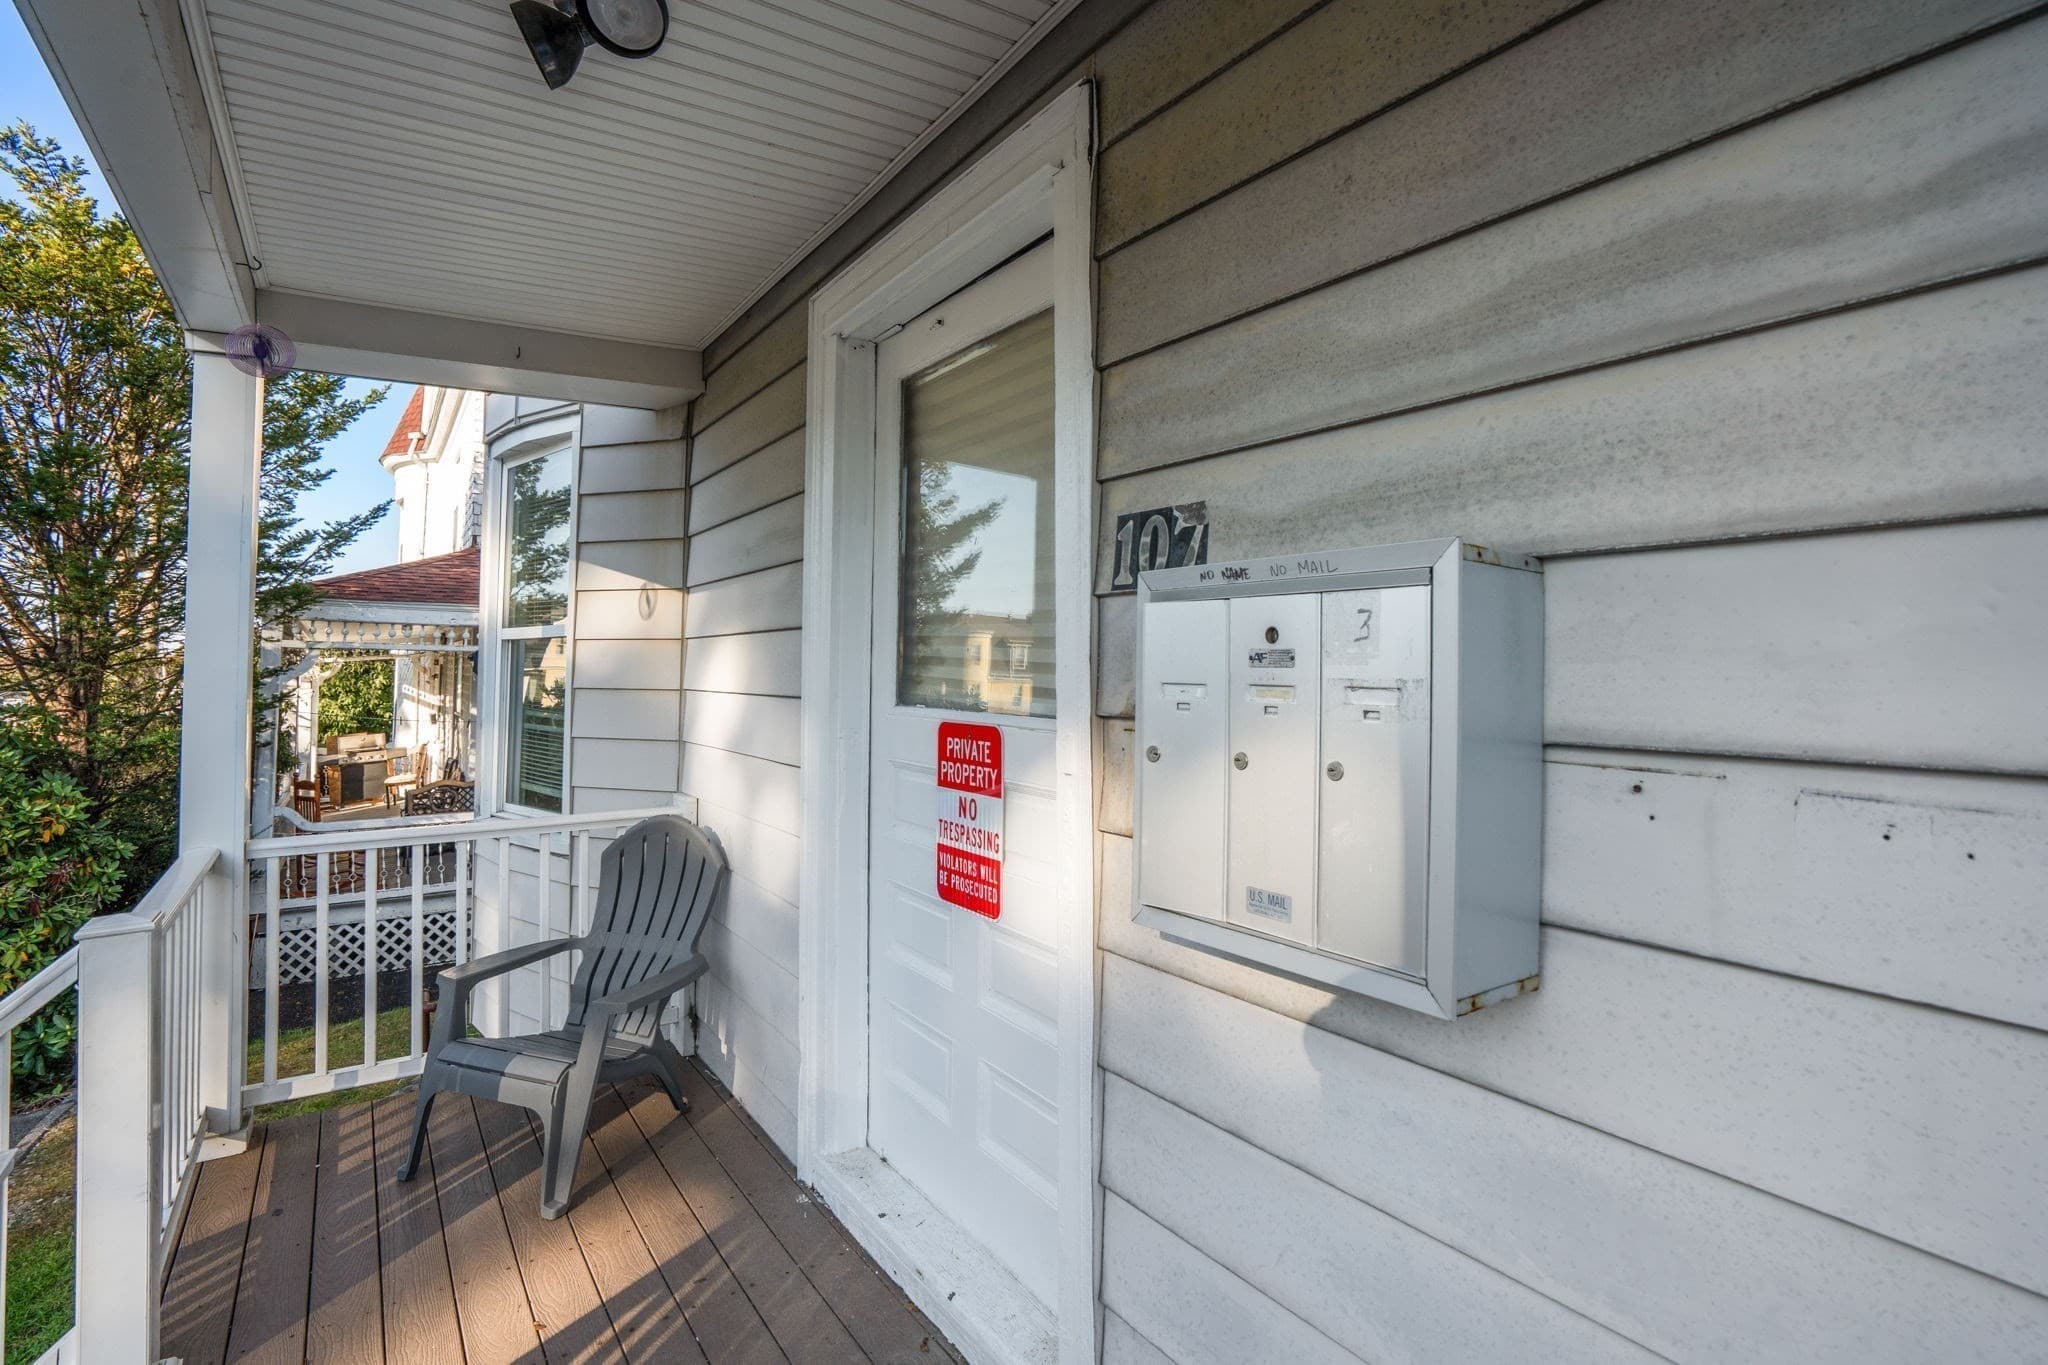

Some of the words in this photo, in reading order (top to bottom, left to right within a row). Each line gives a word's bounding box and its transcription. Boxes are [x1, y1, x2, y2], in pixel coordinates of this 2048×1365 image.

[1114, 507, 1204, 586] 107
[1200, 569, 1215, 582] NO
[1270, 562, 1287, 577] NO
[1297, 559, 1339, 574] MAIL
[1353, 608, 1373, 643] 3
[946, 736, 992, 764] PRIVATE
[940, 760, 998, 791] PROPERTY
[958, 796, 978, 821] NO
[938, 819, 999, 854] TRESPASSING
[939, 851, 978, 878] VIOLATORS
[980, 863, 999, 885] WILL
[939, 869, 949, 887] BE
[950, 873, 998, 904] PROSECUTED
[1267, 894, 1288, 910] MAIL
